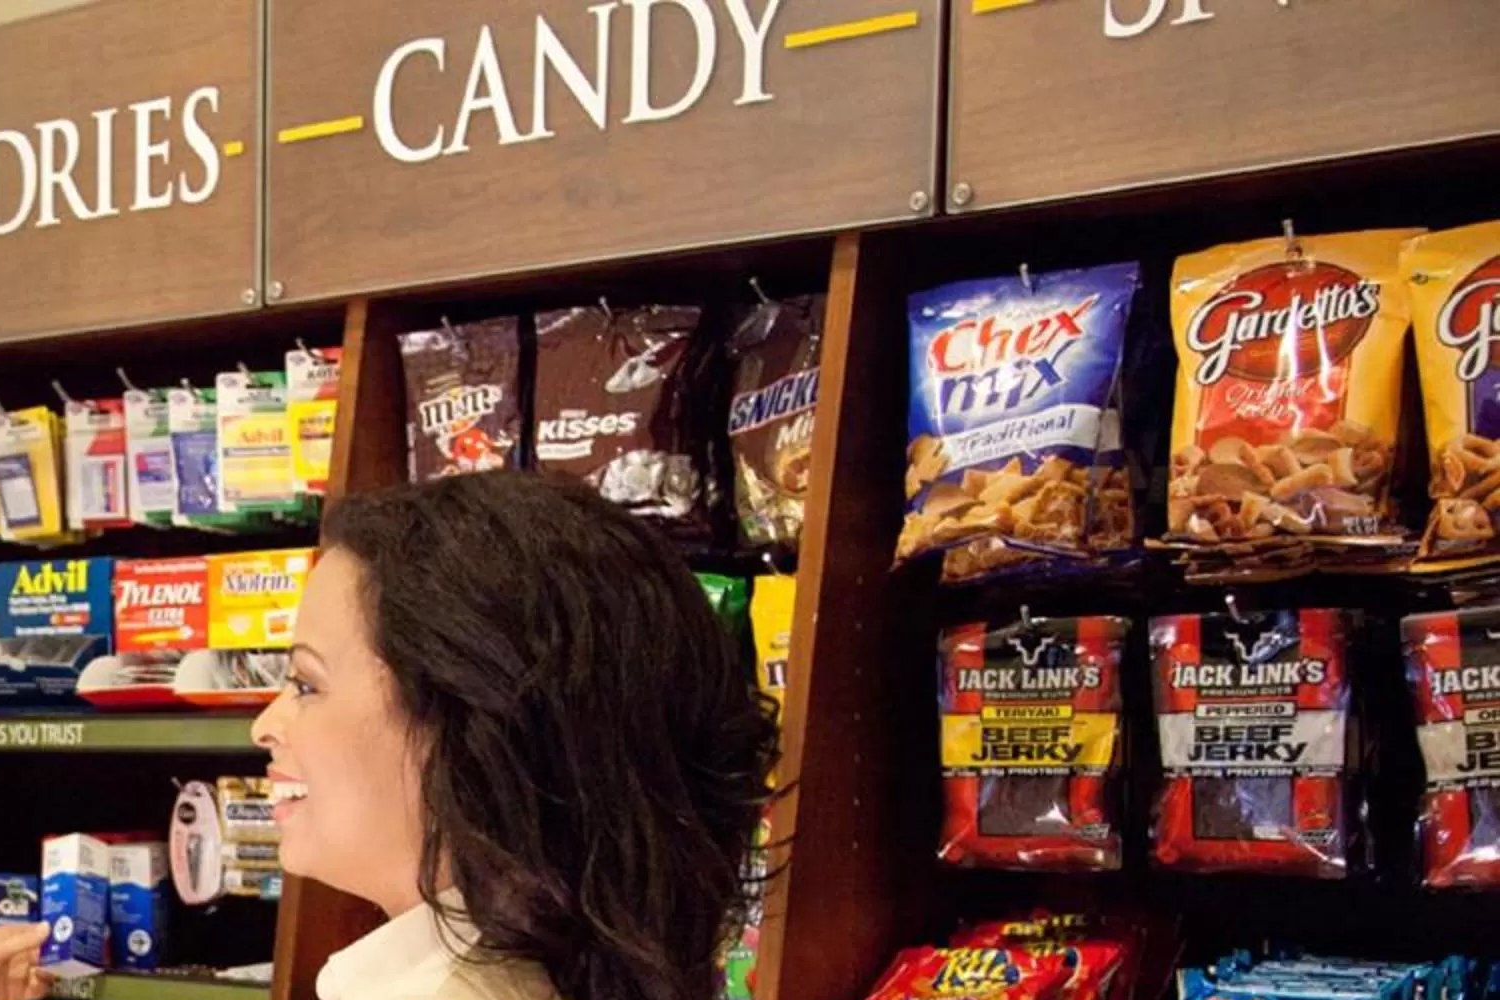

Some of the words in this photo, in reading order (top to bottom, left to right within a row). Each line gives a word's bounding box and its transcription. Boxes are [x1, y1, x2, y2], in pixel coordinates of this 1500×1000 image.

[373, 0, 777, 163] CANDY
[932, 293, 1100, 374] Chex
[1187, 281, 1380, 385] Gardetto's
[940, 338, 1074, 415] mix
[958, 408, 1076, 450] Traditional
[11, 559, 89, 596] Advil
[117, 580, 203, 610] TYLENOL
[958, 668, 1015, 690] JACK
[1172, 662, 1233, 688] JACK
[1240, 659, 1325, 687] LINK'S
[9, 723, 39, 745] YOU
[41, 723, 83, 744] TRUST
[981, 726, 1072, 743] BEEF
[1195, 724, 1294, 743] BEEF
[971, 743, 1083, 762] JERKY
[1187, 742, 1307, 762] JERKY
